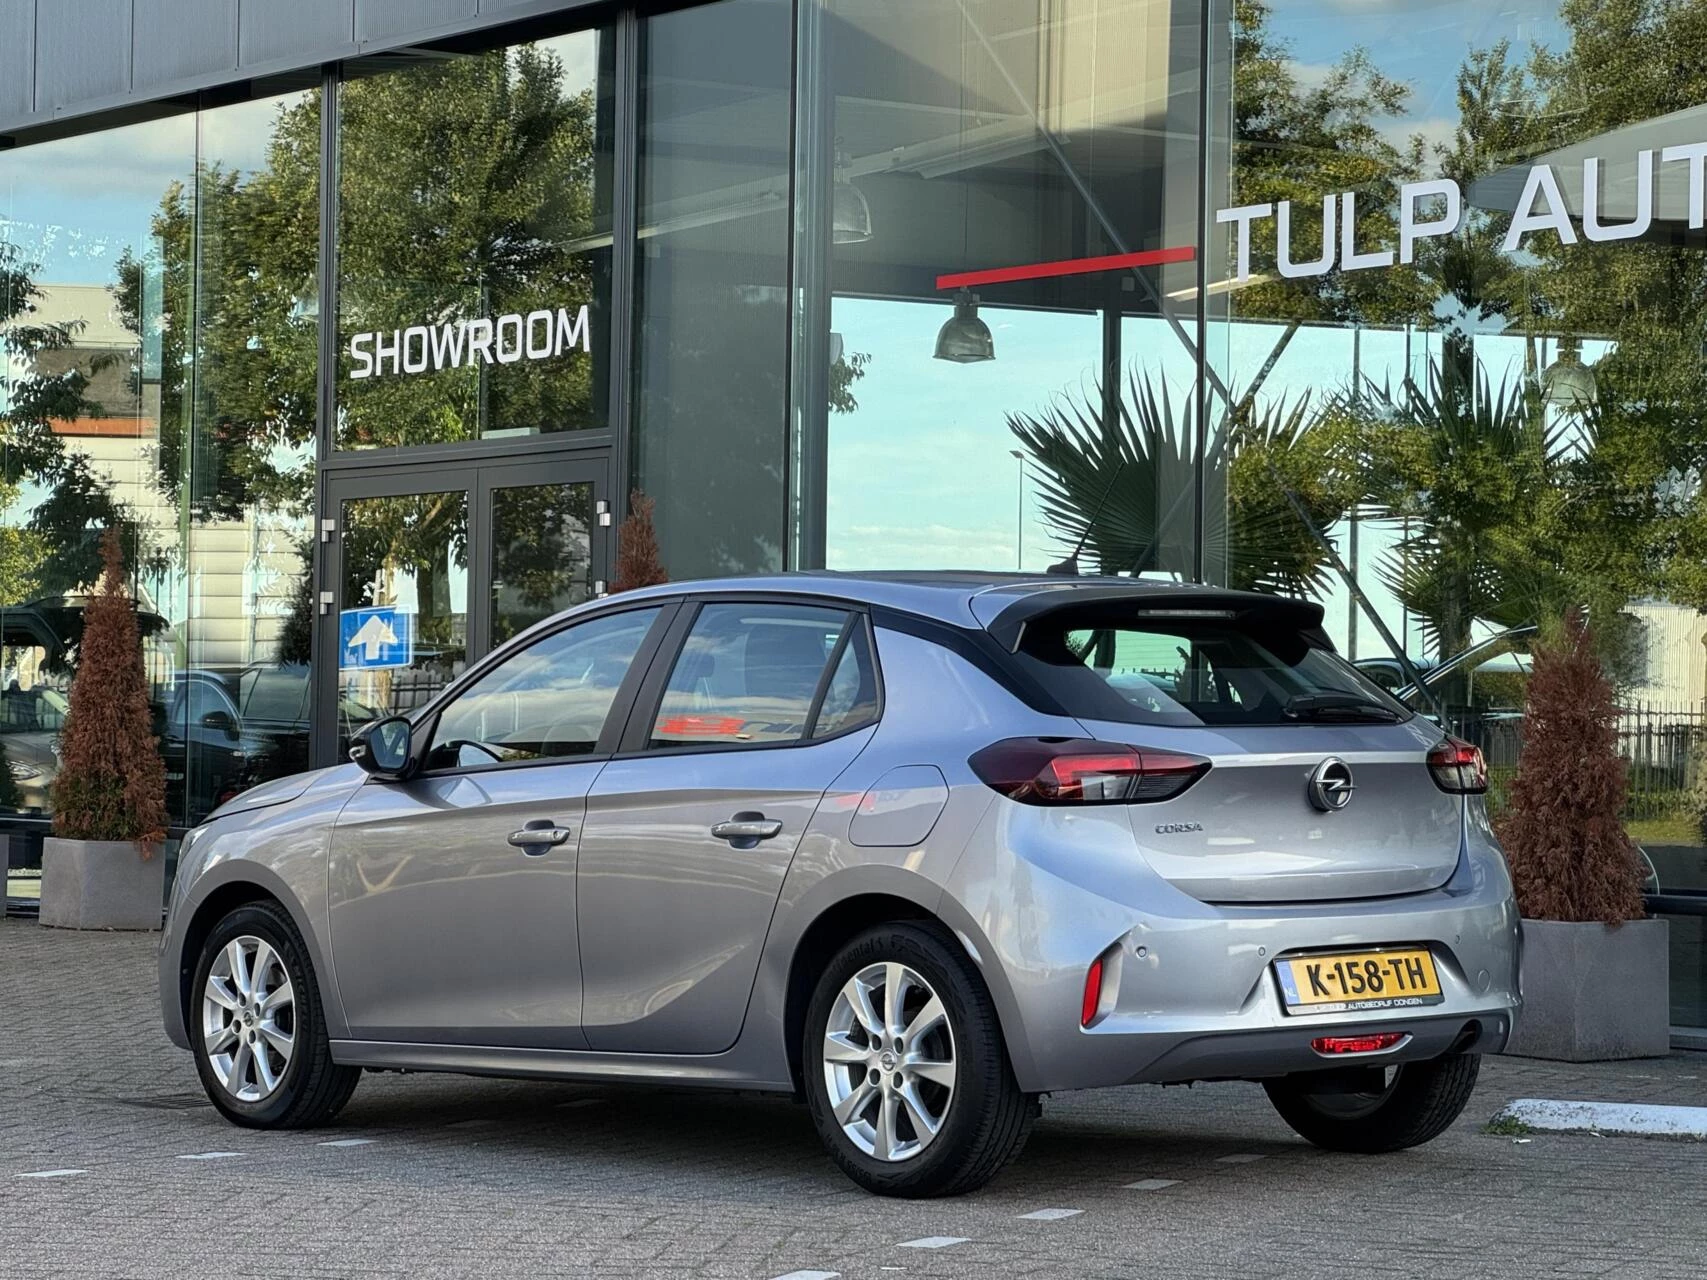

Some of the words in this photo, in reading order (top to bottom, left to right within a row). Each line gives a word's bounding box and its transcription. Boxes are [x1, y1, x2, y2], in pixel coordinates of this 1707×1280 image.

[1216, 178, 1461, 283] TULP
[1500, 142, 1707, 252] AUT
[350, 305, 590, 379] SHOWROOM
[1155, 823, 1203, 834] CORSA
[1306, 957, 1427, 997] K-158-TH
[1394, 998, 1423, 1007] DONGEN
